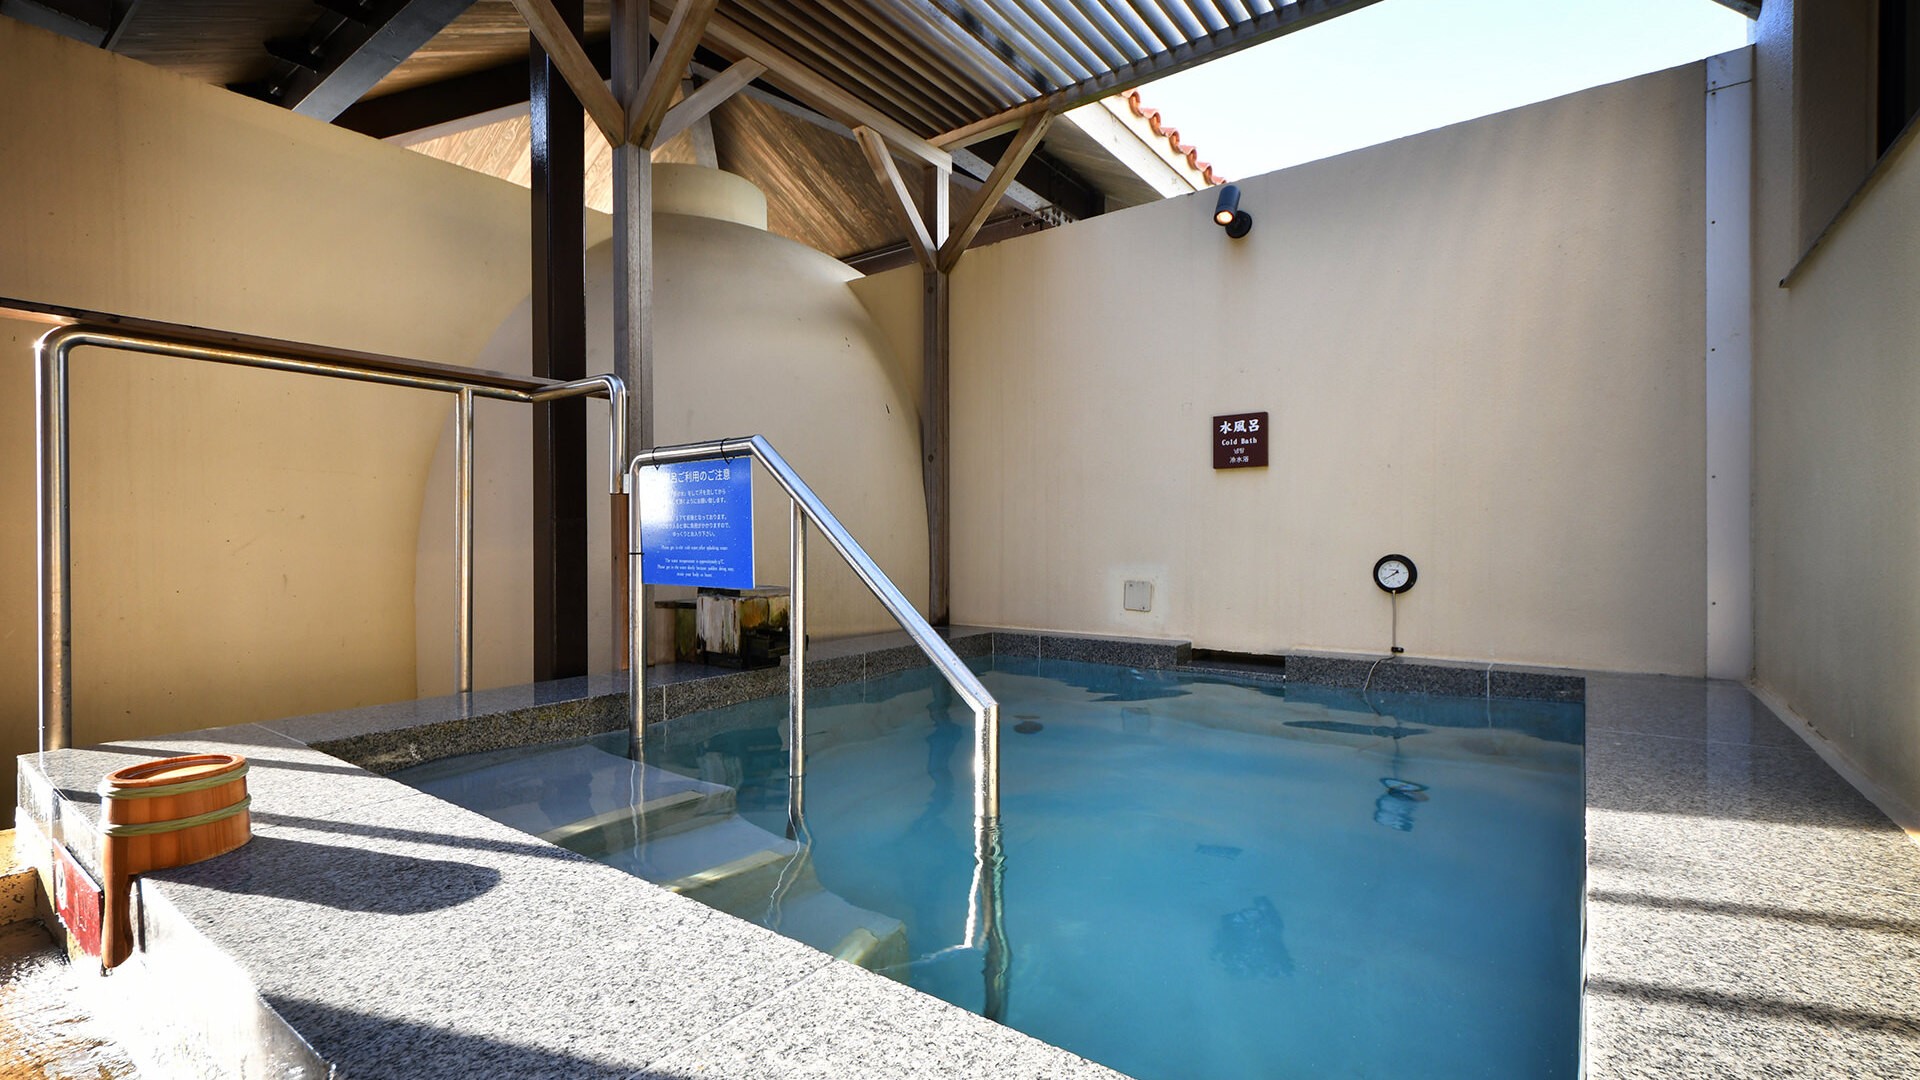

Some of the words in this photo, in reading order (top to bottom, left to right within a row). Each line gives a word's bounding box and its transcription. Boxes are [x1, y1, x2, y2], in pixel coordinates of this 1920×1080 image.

[1219, 419, 1260, 434] 水風呂
[670, 468, 730, 483] 呂ご利用のご注意
